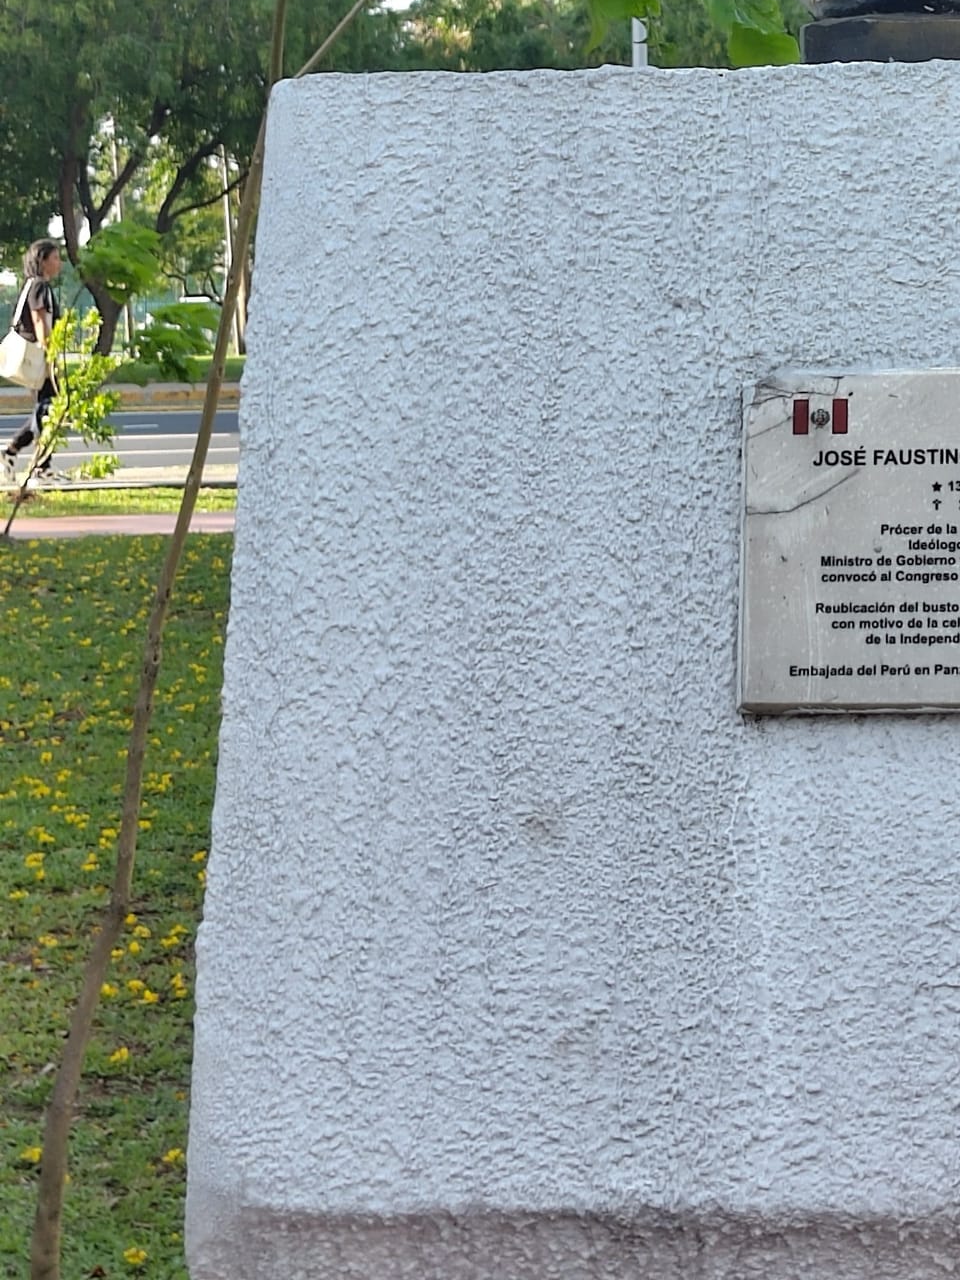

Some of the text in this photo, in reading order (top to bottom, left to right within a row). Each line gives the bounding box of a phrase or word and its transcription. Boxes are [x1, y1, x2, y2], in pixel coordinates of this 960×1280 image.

[812, 445, 867, 467] JOSÉ
[880, 523, 924, 536] Prócer
[926, 523, 943, 535] de
[945, 522, 958, 535] la
[820, 555, 873, 567] Ministro
[876, 554, 893, 567] de
[895, 554, 957, 567] Gobierno
[820, 570, 878, 583] convocó
[880, 570, 892, 582] al
[895, 570, 959, 585] Congreso
[815, 601, 896, 615] Reubicación
[898, 601, 919, 614] del
[922, 601, 960, 613] busto
[831, 620, 856, 630] con
[858, 616, 904, 630] motivo
[906, 617, 923, 629] de
[926, 616, 939, 629] la
[864, 633, 882, 645] de
[885, 632, 897, 645] la
[788, 664, 854, 680] Embajada
[856, 664, 877, 677] del
[880, 663, 911, 677] Perú
[913, 666, 931, 676] en
